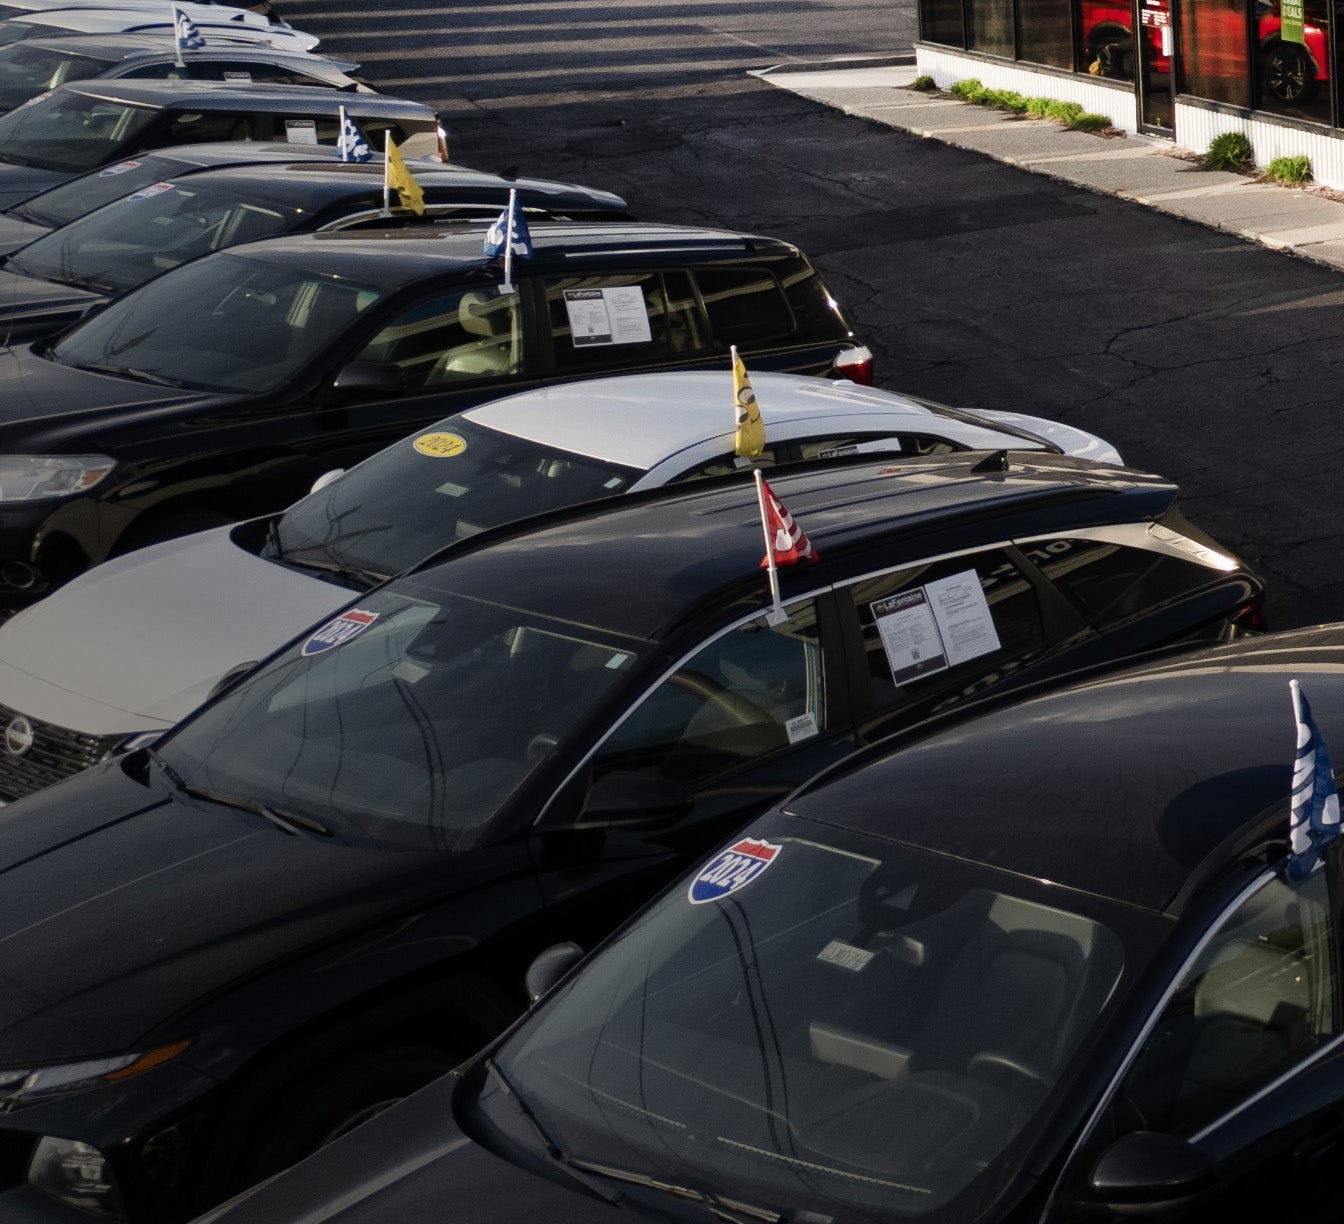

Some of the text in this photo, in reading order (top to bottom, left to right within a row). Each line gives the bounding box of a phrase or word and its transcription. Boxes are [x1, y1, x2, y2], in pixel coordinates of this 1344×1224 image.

[418, 435, 462, 454] 2024
[312, 619, 363, 645] 2024
[700, 852, 763, 891] 2024
